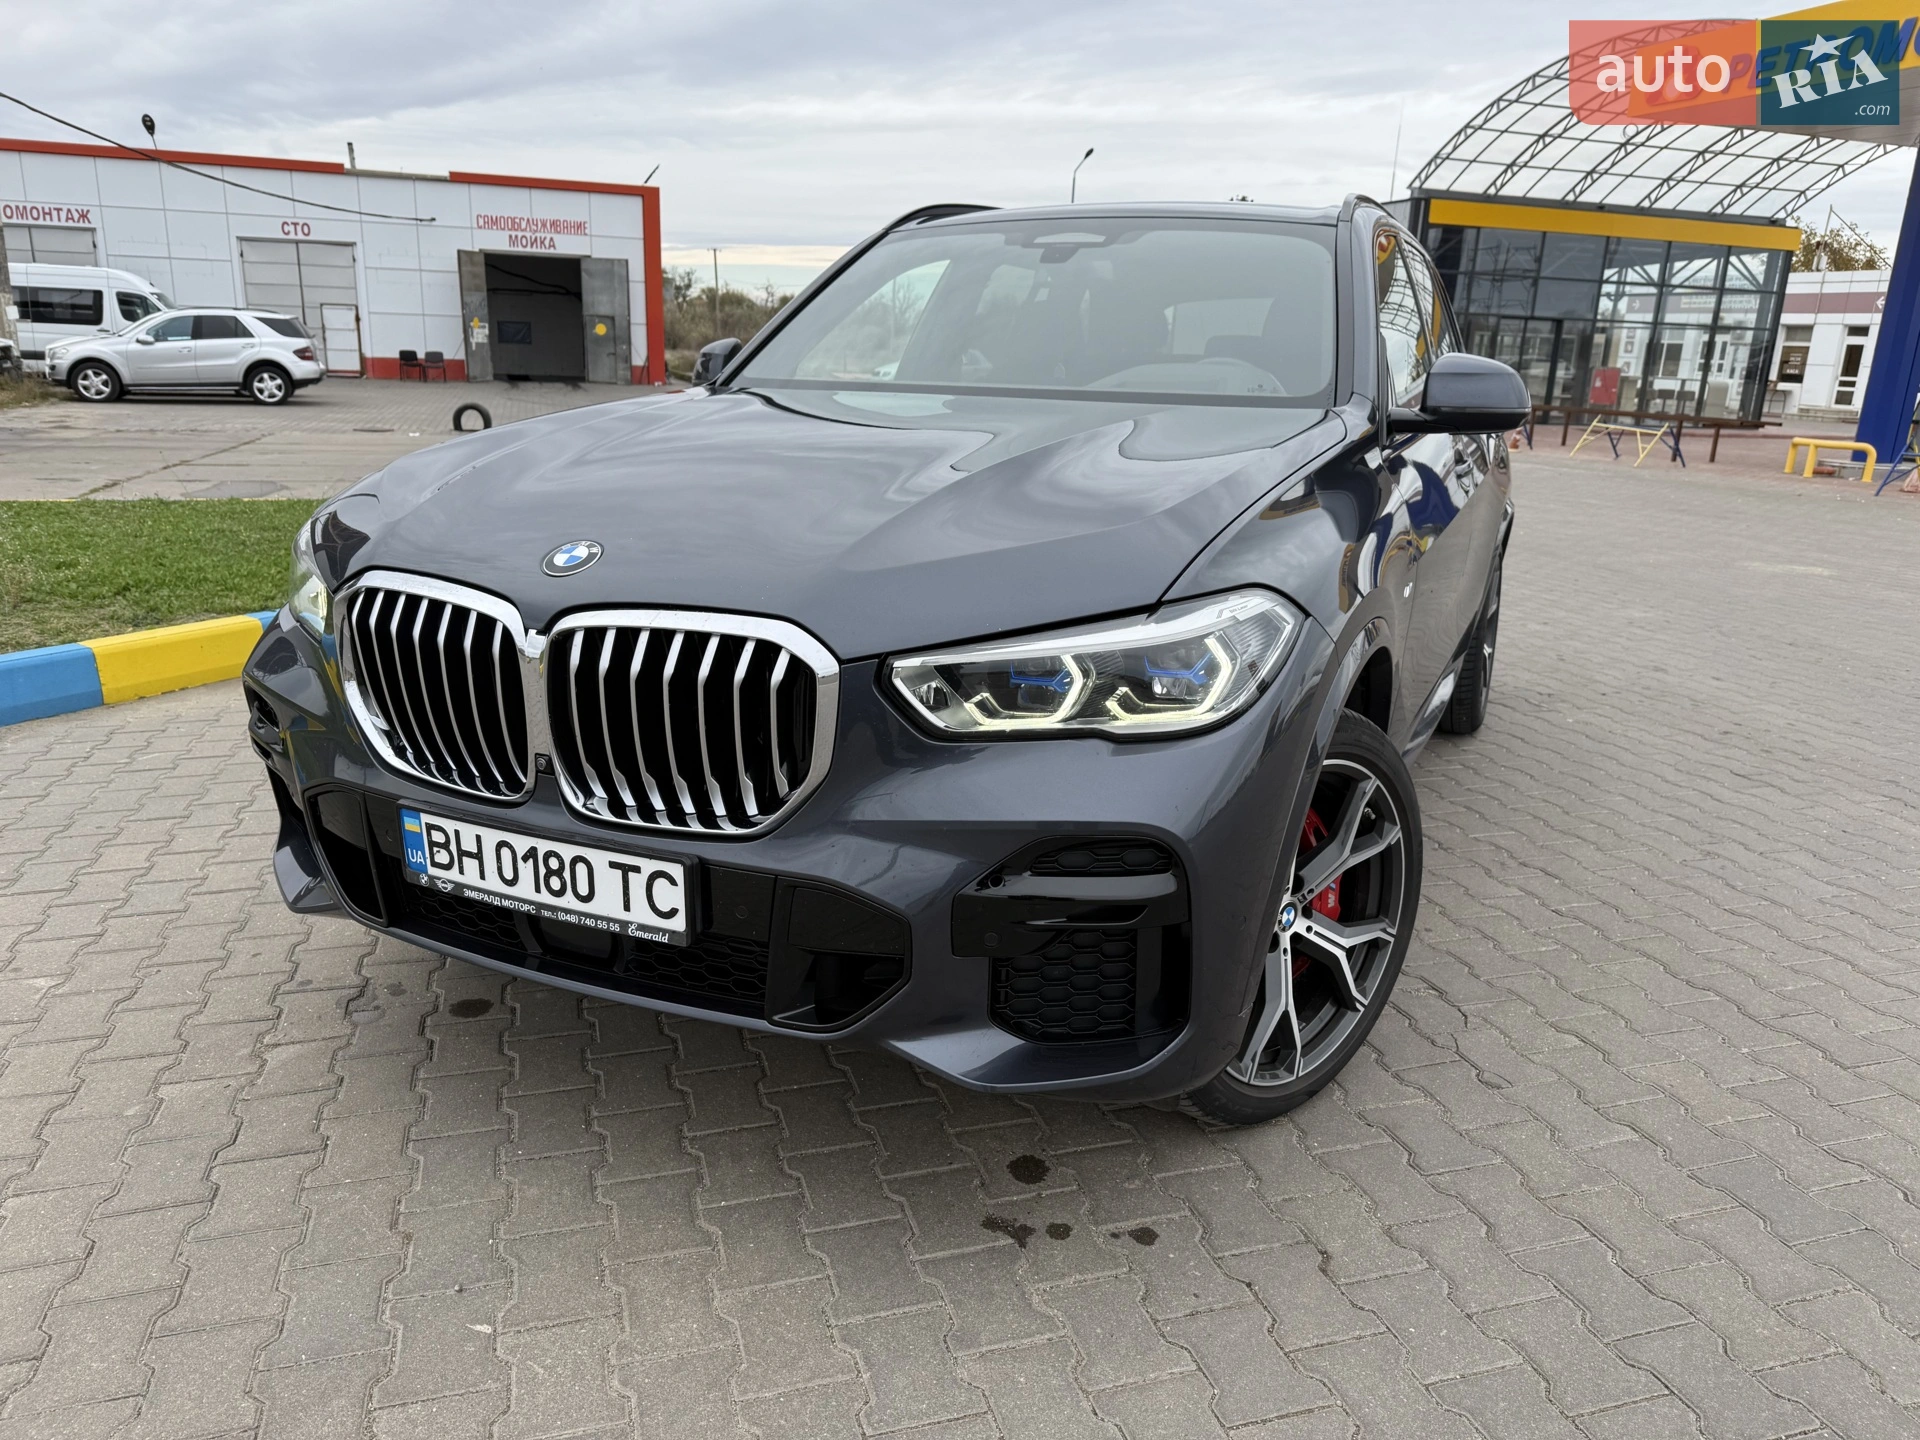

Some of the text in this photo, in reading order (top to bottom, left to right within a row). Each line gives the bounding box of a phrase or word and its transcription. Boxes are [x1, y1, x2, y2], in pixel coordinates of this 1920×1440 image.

[1721, 16, 1920, 93] PETROM
[3, 204, 92, 224] ОМОНТАЖ
[281, 221, 311, 237] СТО
[476, 214, 588, 236] САМООБСЛУЖИВАНИЕ
[508, 232, 556, 250] МОЙКА
[408, 848, 425, 865] UA
[425, 821, 680, 920] BH 0180 TC
[463, 888, 500, 907] ЭМЕРАЛД
[502, 898, 536, 914] МОТОРС
[558, 911, 579, 924] (048)
[580, 916, 596, 927] 740
[597, 920, 608, 929] 55
[609, 922, 620, 932] 55
[628, 922, 669, 943] Emerald
